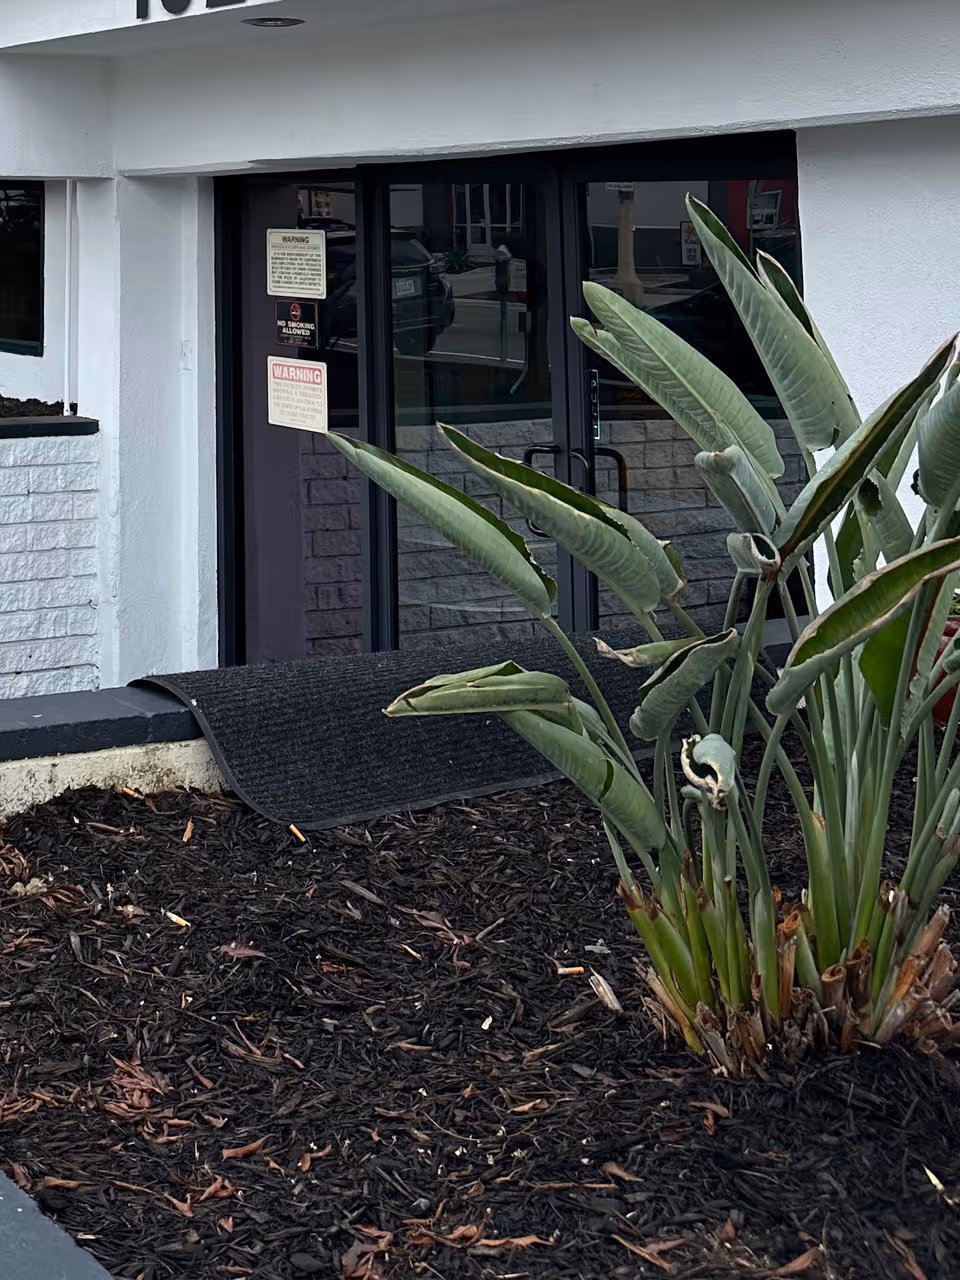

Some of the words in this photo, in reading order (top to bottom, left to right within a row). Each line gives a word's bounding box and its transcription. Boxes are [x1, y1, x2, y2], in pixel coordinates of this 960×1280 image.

[281, 235, 310, 244] WARNING
[287, 321, 315, 330] SMOKING
[282, 327, 311, 336] ALLOWED
[273, 365, 322, 384] WARNING
